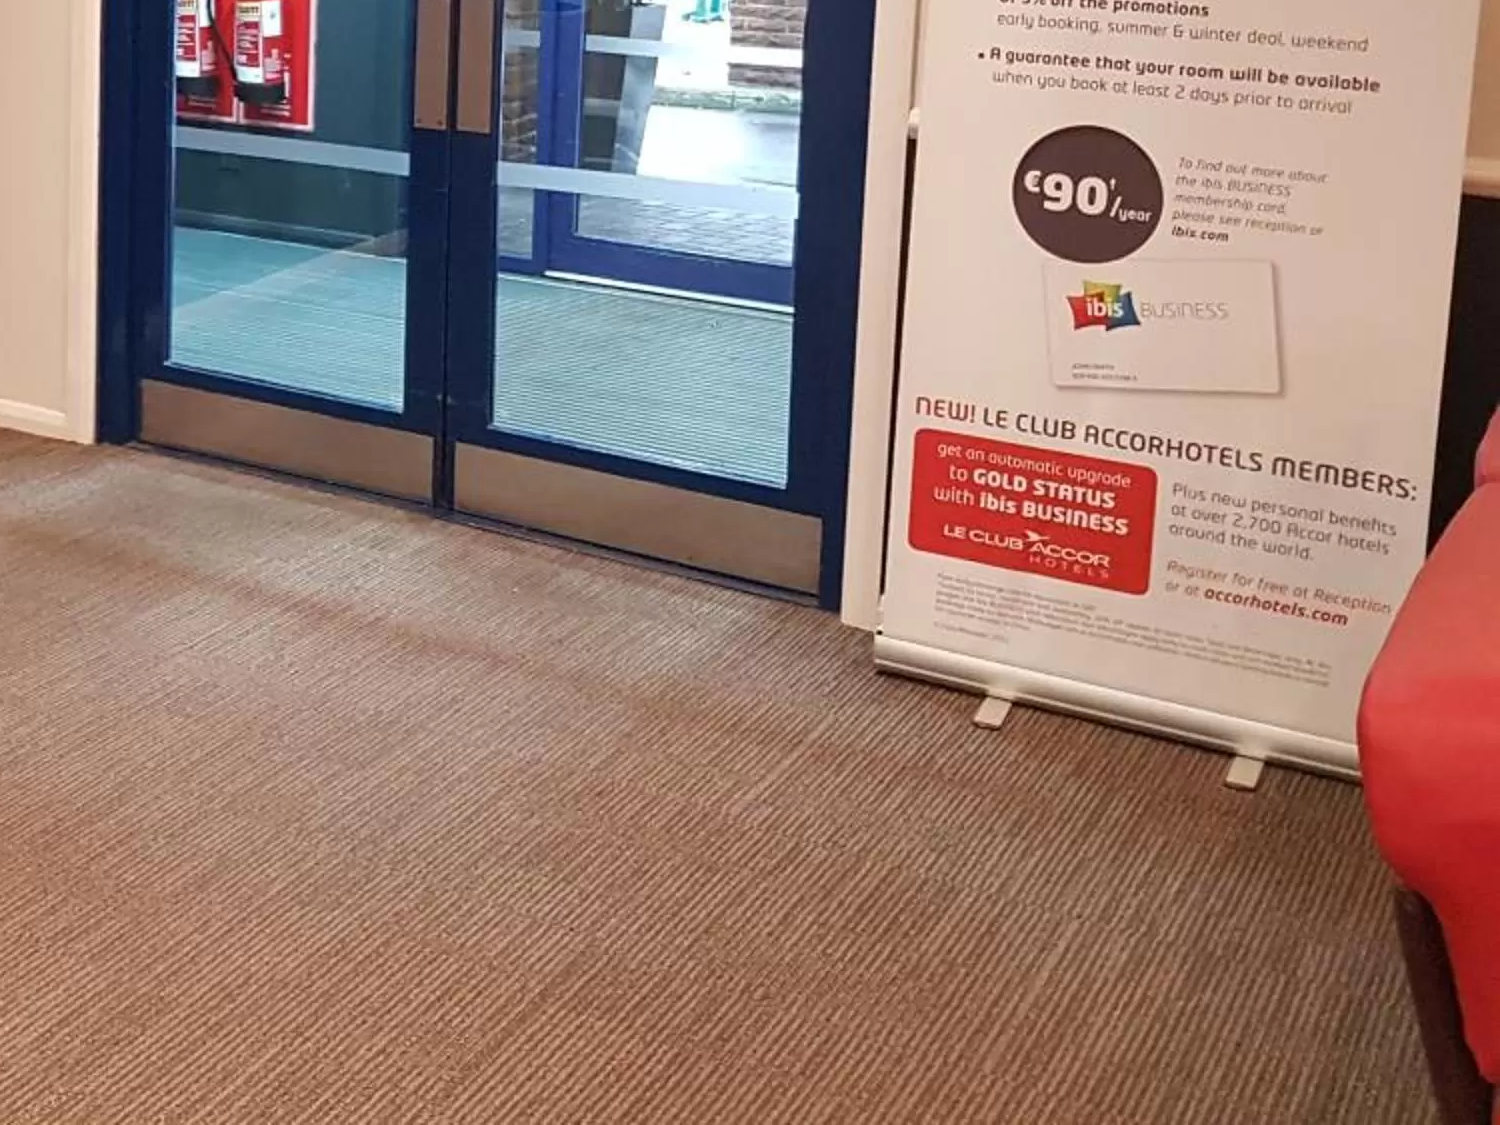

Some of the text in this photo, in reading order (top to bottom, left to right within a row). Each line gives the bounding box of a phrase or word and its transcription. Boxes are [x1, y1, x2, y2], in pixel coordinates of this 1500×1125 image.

[1113, 0, 1209, 16] promotions
[997, 14, 1035, 29] early
[1108, 22, 1167, 36] summer
[1173, 25, 1183, 37] &
[1189, 26, 1241, 42] winter
[1291, 35, 1369, 52] weekend
[990, 47, 1381, 92] A guarantee that your room will be available
[993, 70, 1352, 114] when you book at least 2 days prior to arrival
[1087, 297, 1230, 319] ibis BUSINESS
[916, 396, 1418, 501] NEW! LE CLUB ACCORHOTELS MEMBERS:
[938, 444, 1131, 488] get an automatic upgrade
[950, 465, 1116, 508] to GOLD STATUS
[934, 485, 1129, 536] with ibis BUSINESS
[1171, 504, 1186, 517] at
[1192, 508, 1227, 524] over
[1287, 522, 1332, 543] Accor
[1338, 531, 1390, 555] hotels
[1172, 482, 1397, 536] Plus new personal benefits
[944, 524, 1111, 568] LE CLUB ACCOR
[1169, 524, 1225, 545] around
[1230, 532, 1259, 549] the
[1204, 588, 1349, 626] accorhotels.com
[1314, 588, 1392, 614] Reception
